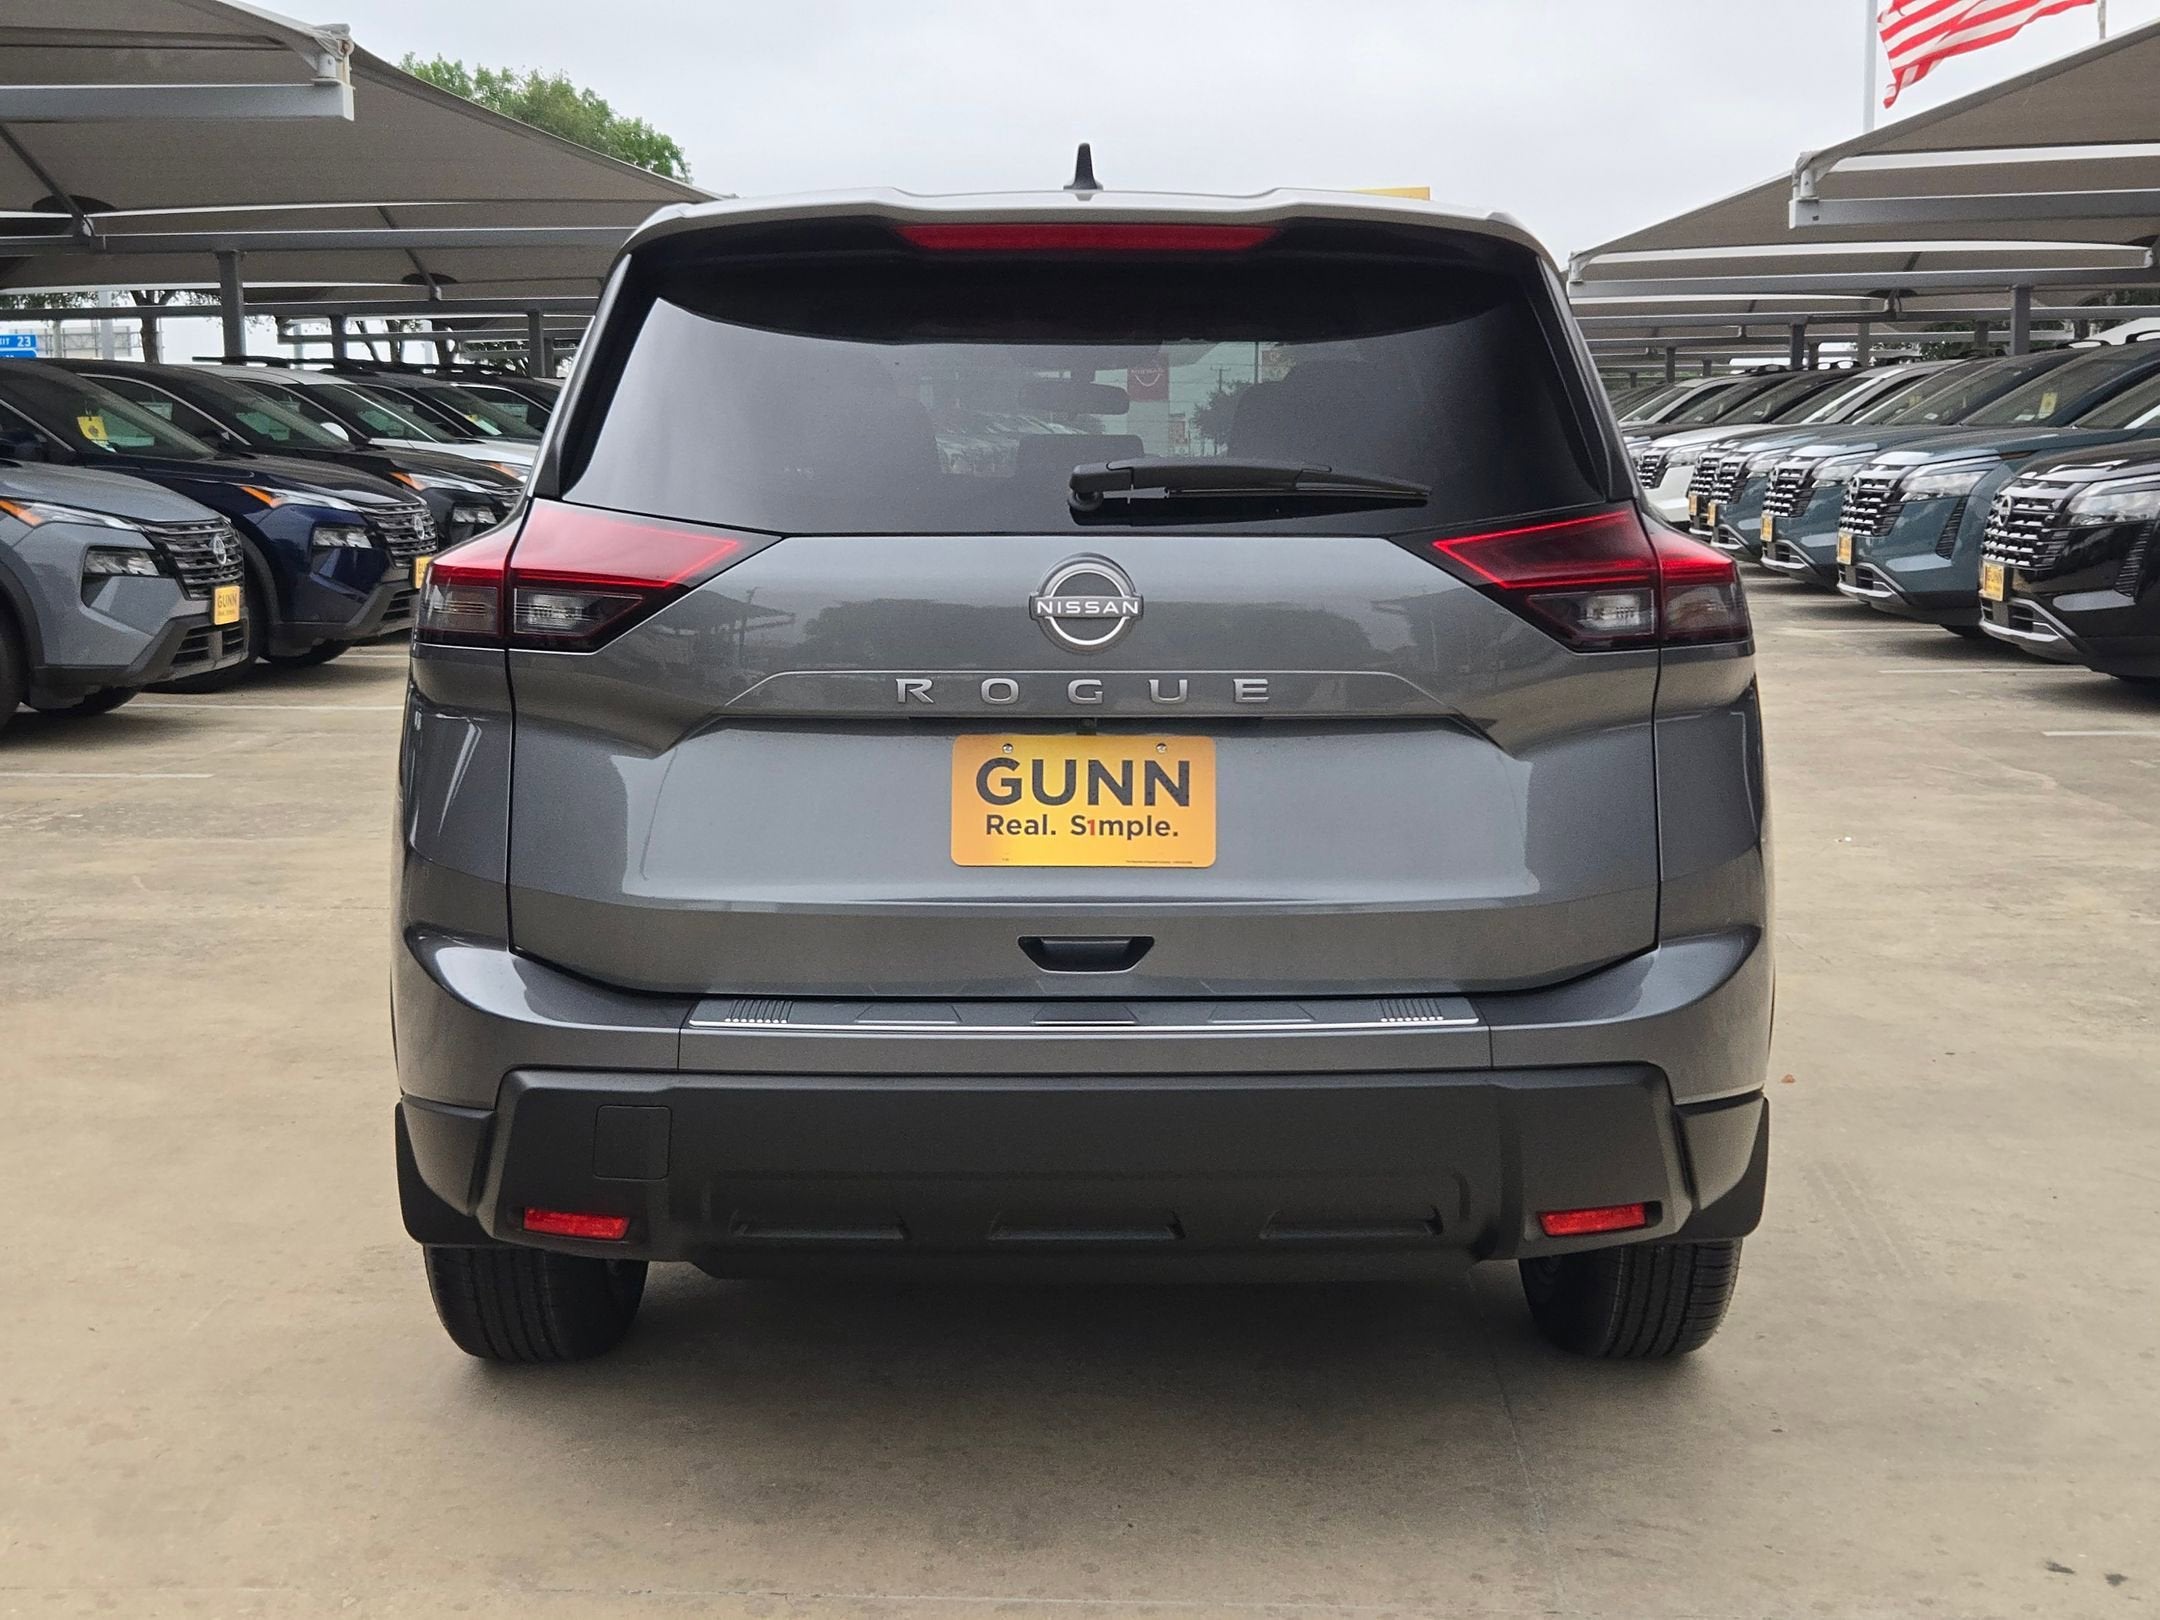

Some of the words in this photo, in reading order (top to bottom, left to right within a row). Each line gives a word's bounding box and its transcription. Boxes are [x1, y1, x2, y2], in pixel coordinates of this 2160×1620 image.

[17, 336, 31, 347] 23
[1037, 601, 1138, 614] NISSAN
[896, 678, 1269, 704] ROGUE
[976, 757, 1190, 807] GUNN
[986, 814, 1056, 835] Real.
